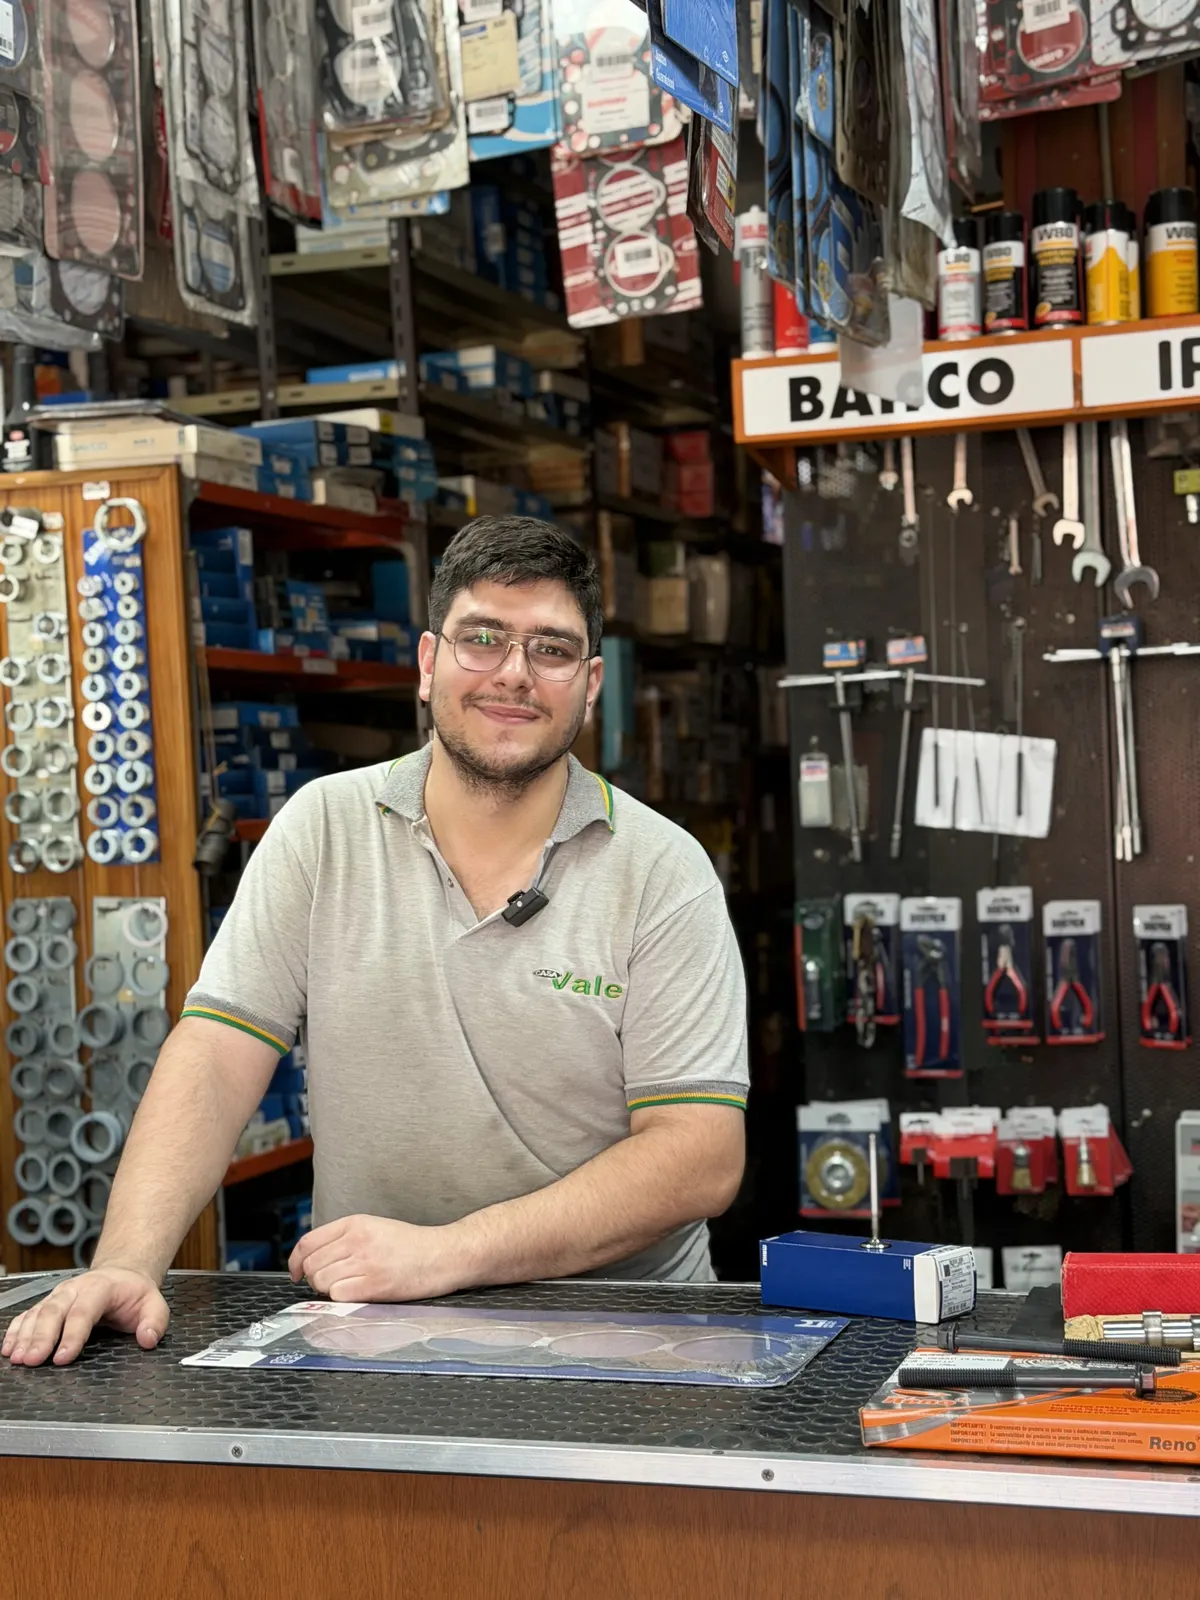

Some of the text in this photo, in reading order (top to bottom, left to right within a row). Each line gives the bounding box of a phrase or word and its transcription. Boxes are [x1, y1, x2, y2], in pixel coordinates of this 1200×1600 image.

[535, 969, 558, 978] CASA
[552, 972, 622, 998] Vale
[1149, 1436, 1197, 1452] Reno
